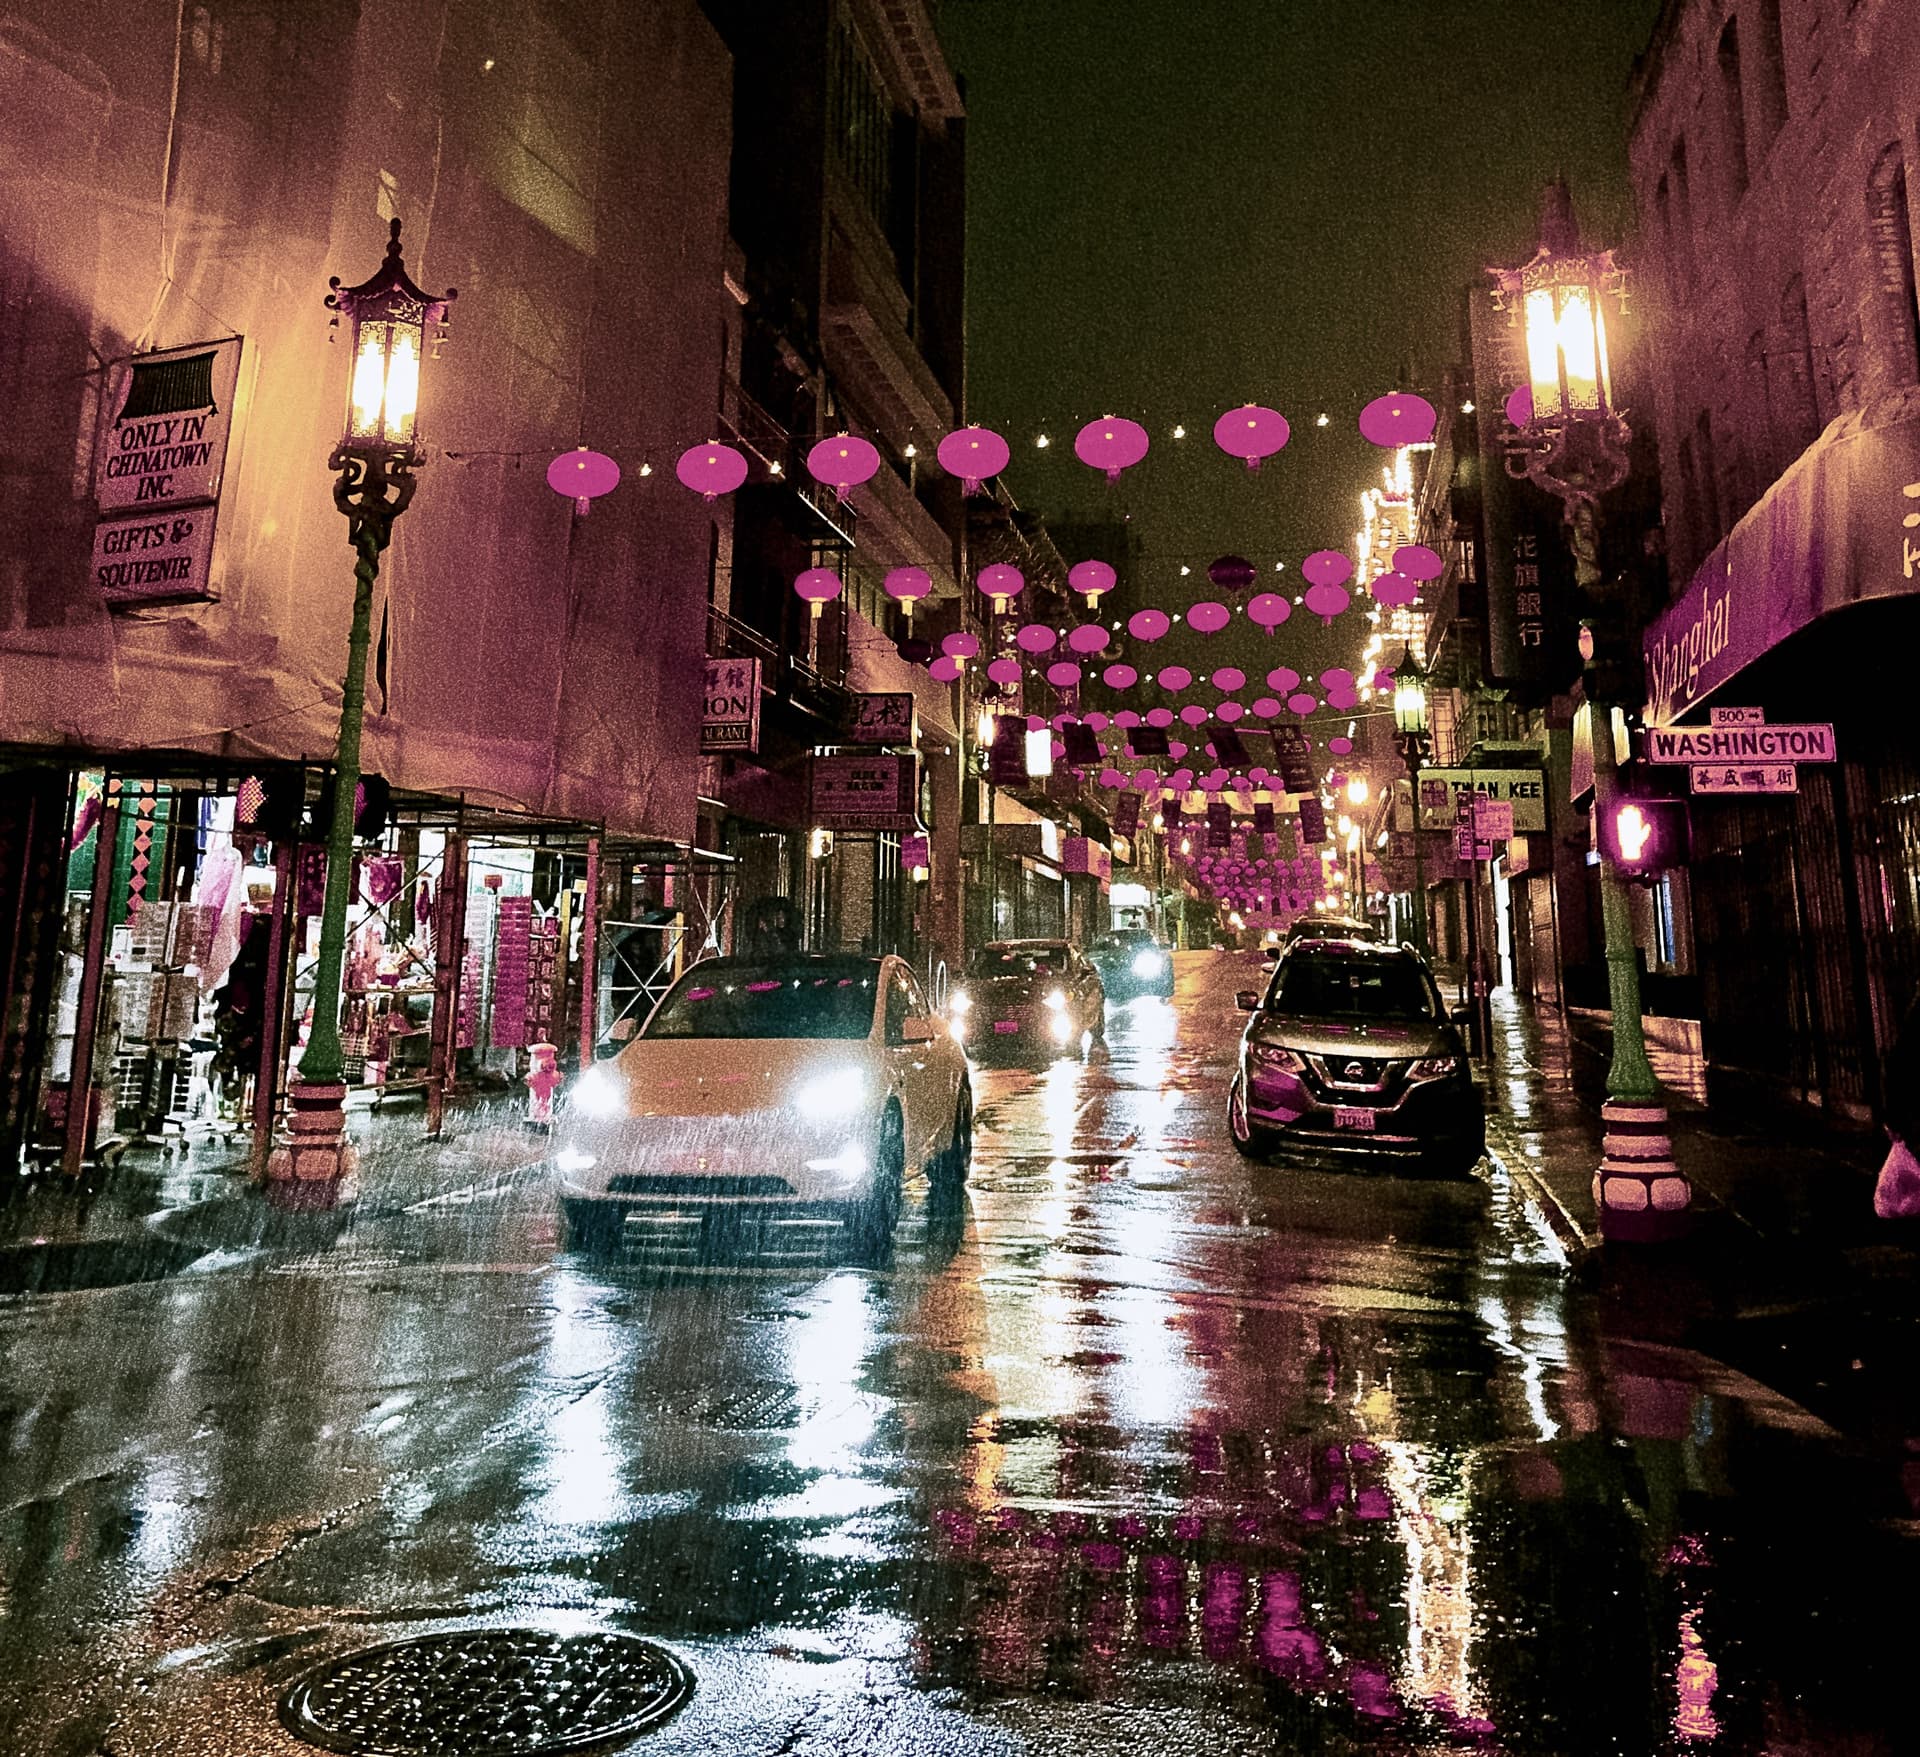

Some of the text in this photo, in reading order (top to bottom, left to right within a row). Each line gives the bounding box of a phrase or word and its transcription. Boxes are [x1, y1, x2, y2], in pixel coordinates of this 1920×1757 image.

[121, 415, 209, 451] ONLY IN
[107, 441, 213, 479] CHINATOWN
[134, 475, 174, 501] INC.
[103, 518, 194, 555] GIFTS &
[98, 556, 192, 588] SOUVENIR
[1513, 535, 1544, 648] 花旗銀行
[1652, 561, 1732, 722] Shanghai
[1718, 710, 1745, 722] 800
[1655, 731, 1826, 757] WASHINGTON
[1509, 781, 1541, 799] KEE
